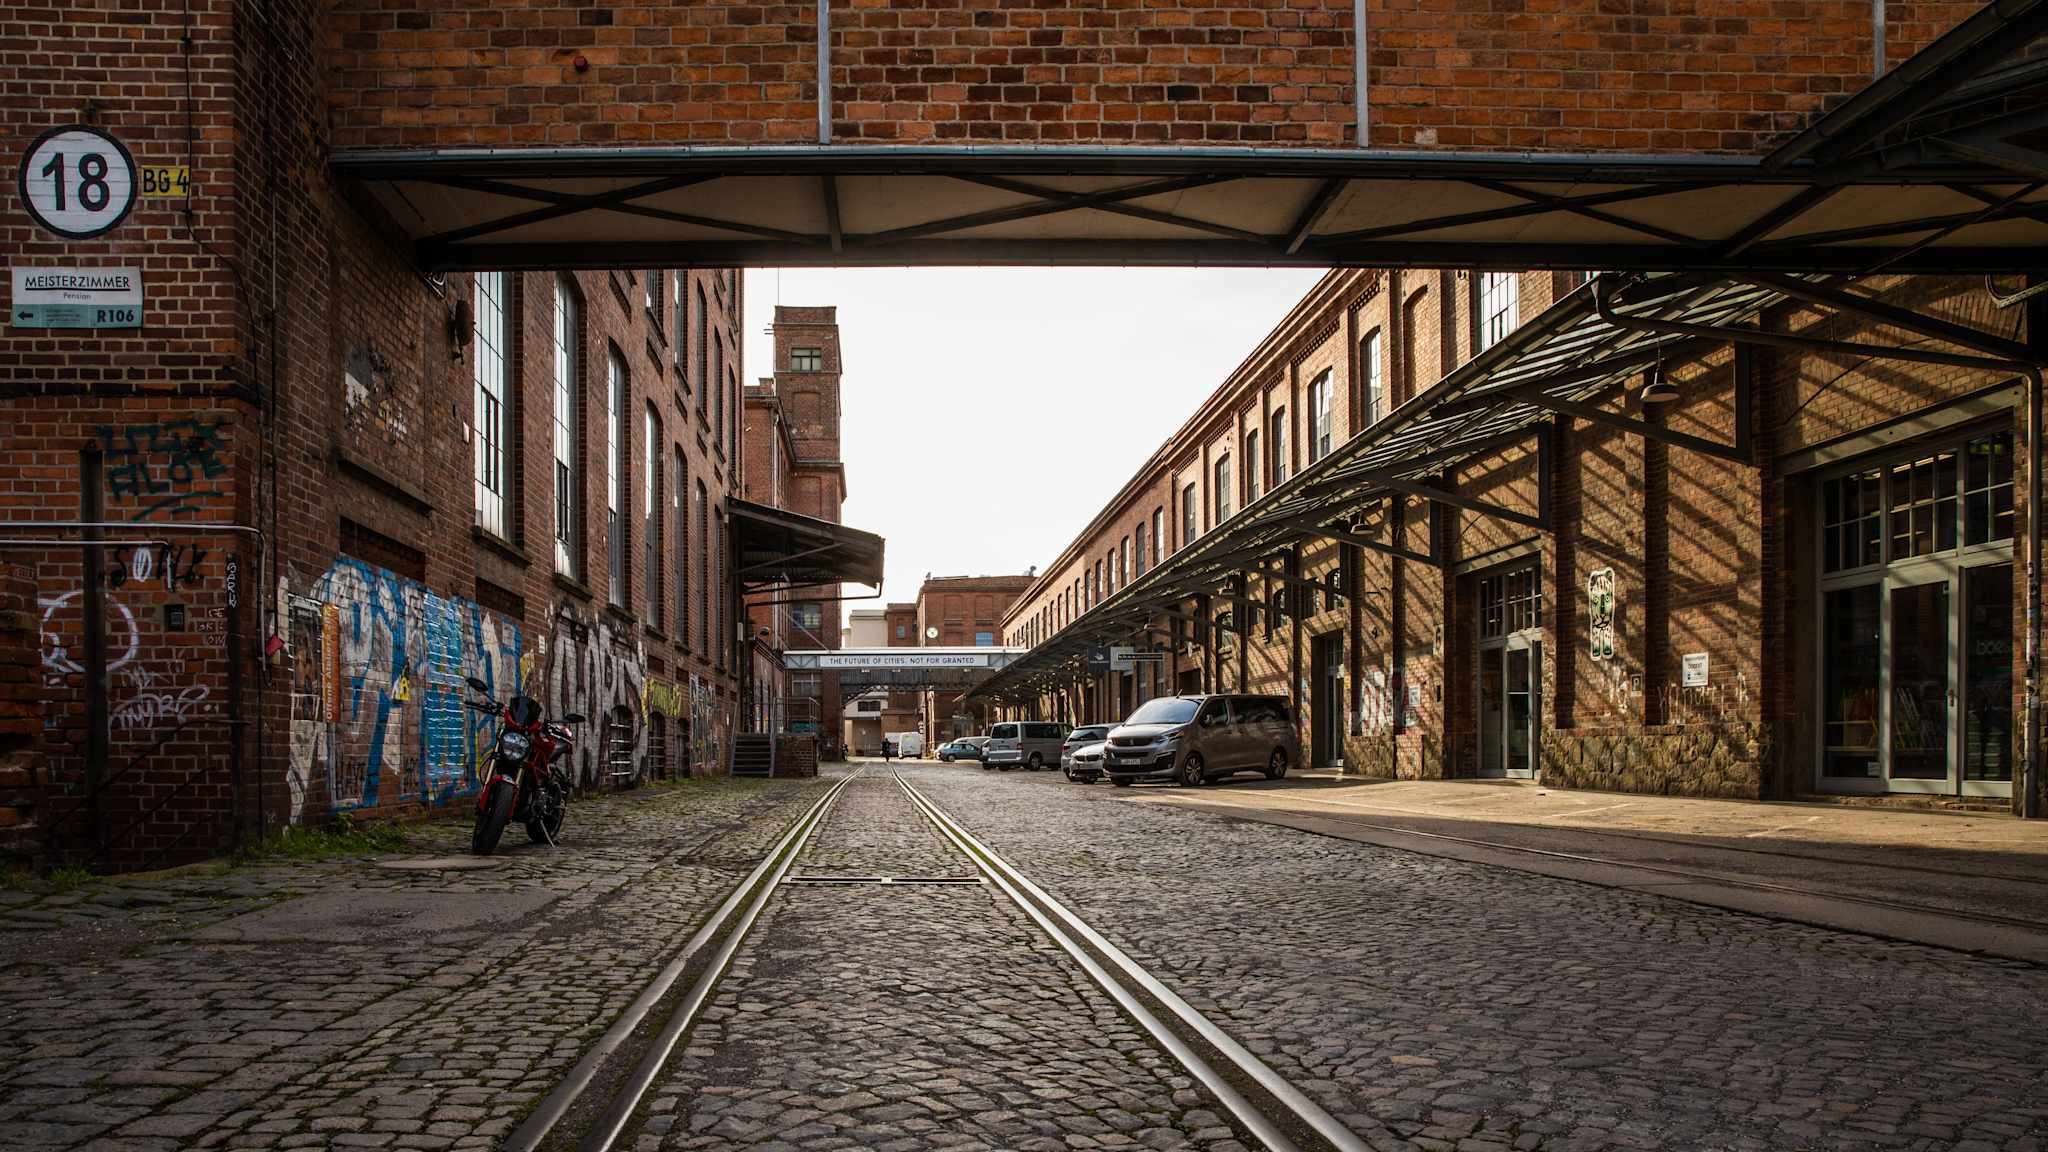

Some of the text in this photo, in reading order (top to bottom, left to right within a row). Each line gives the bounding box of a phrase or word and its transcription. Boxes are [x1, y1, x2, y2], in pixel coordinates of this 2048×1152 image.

[42, 152, 111, 212] 18
[25, 275, 130, 289] MEISTERZIMMER
[63, 292, 92, 300] Pension
[97, 309, 134, 323] R106
